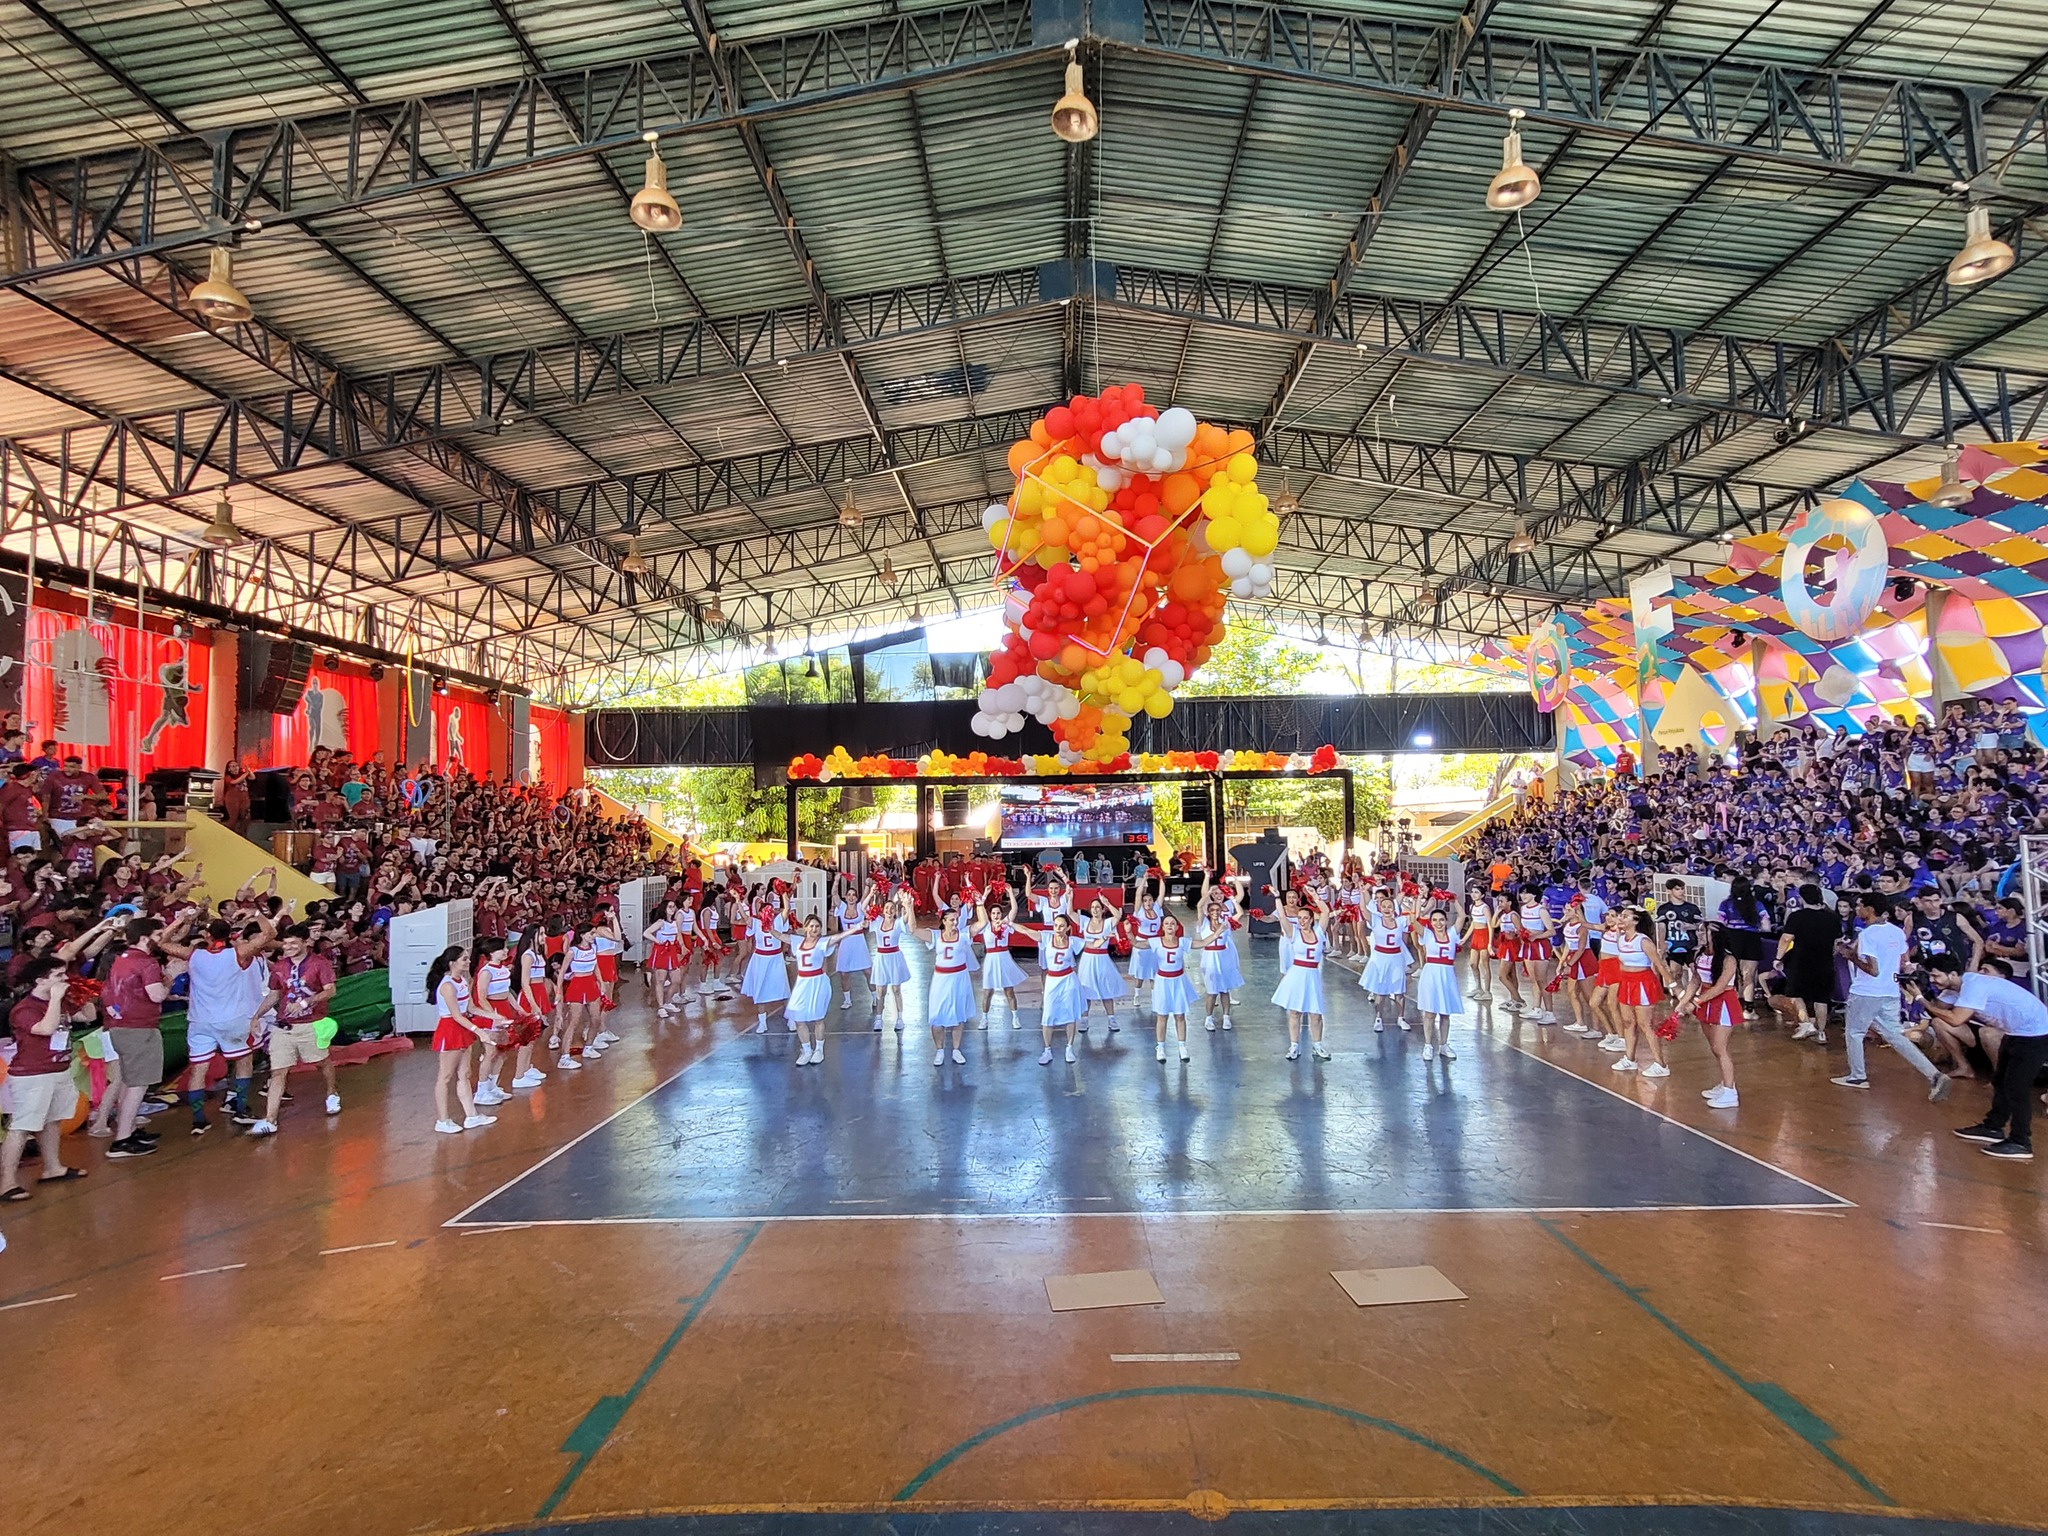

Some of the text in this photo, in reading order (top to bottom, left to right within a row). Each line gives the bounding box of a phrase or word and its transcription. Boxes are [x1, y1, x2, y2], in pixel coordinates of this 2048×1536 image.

[764, 936, 772, 947] C
[883, 936, 890, 947] C
[1386, 934, 1395, 945] C
[1667, 931, 1690, 941] LIA
[944, 946, 953, 960] C
[1054, 953, 1065, 964] C
[1167, 952, 1176, 963] C
[1306, 948, 1315, 959] C
[802, 954, 812, 967] C
